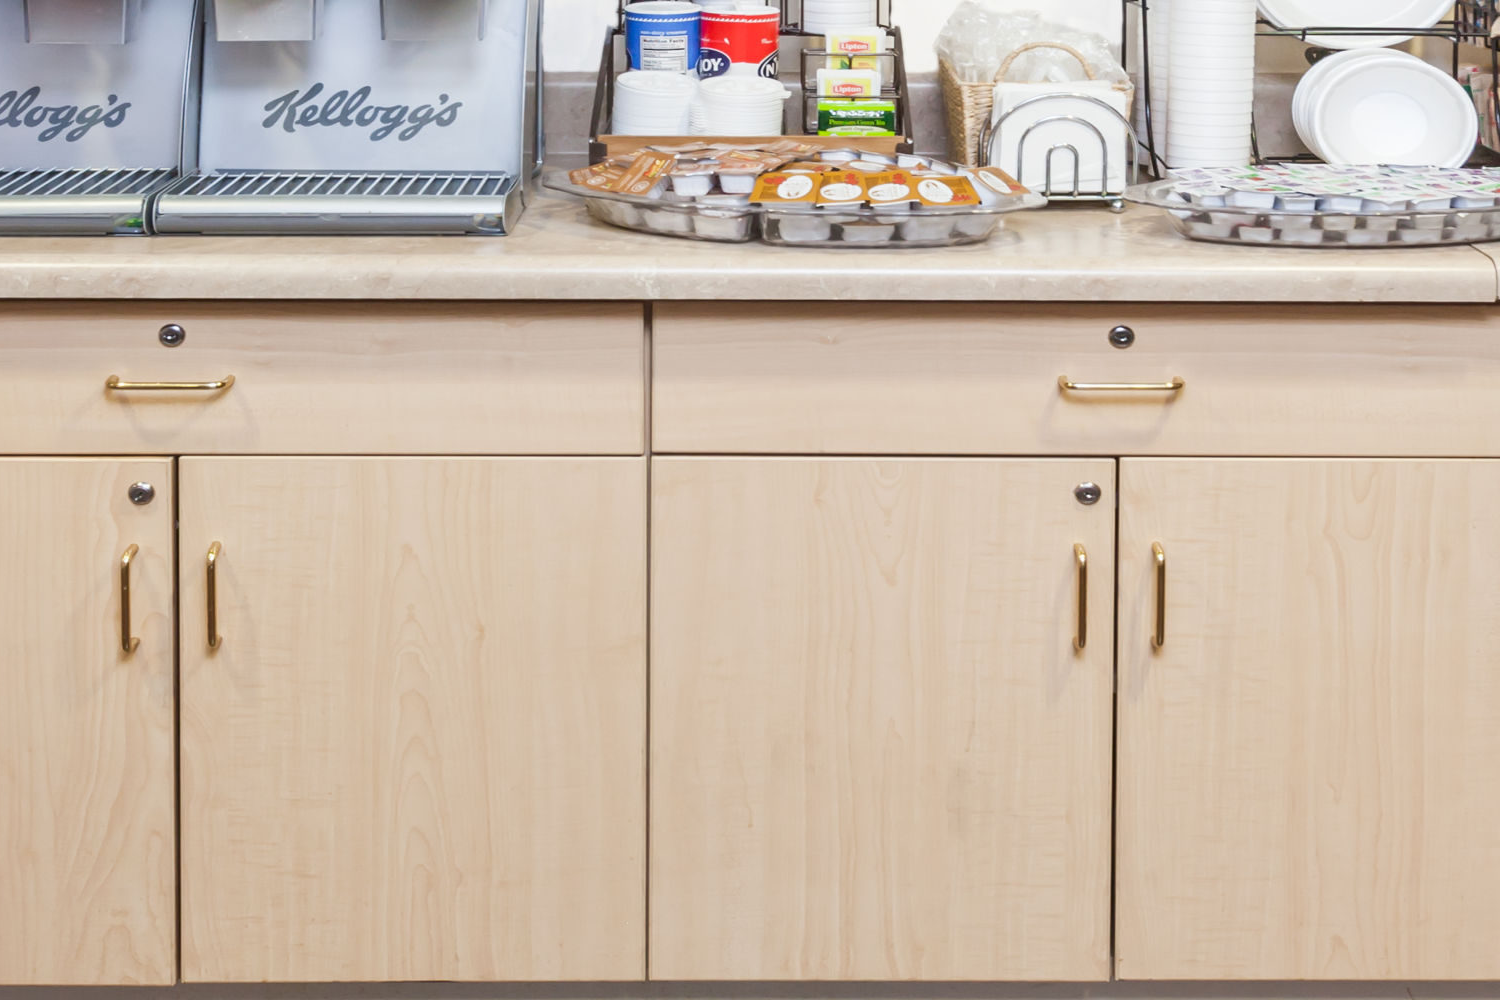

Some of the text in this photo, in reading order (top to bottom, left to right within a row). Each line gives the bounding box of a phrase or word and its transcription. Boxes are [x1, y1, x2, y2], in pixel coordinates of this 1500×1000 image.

[841, 42, 868, 51] Lipton
[834, 85, 862, 95] Lipton
[262, 82, 463, 143] Kellogg's
